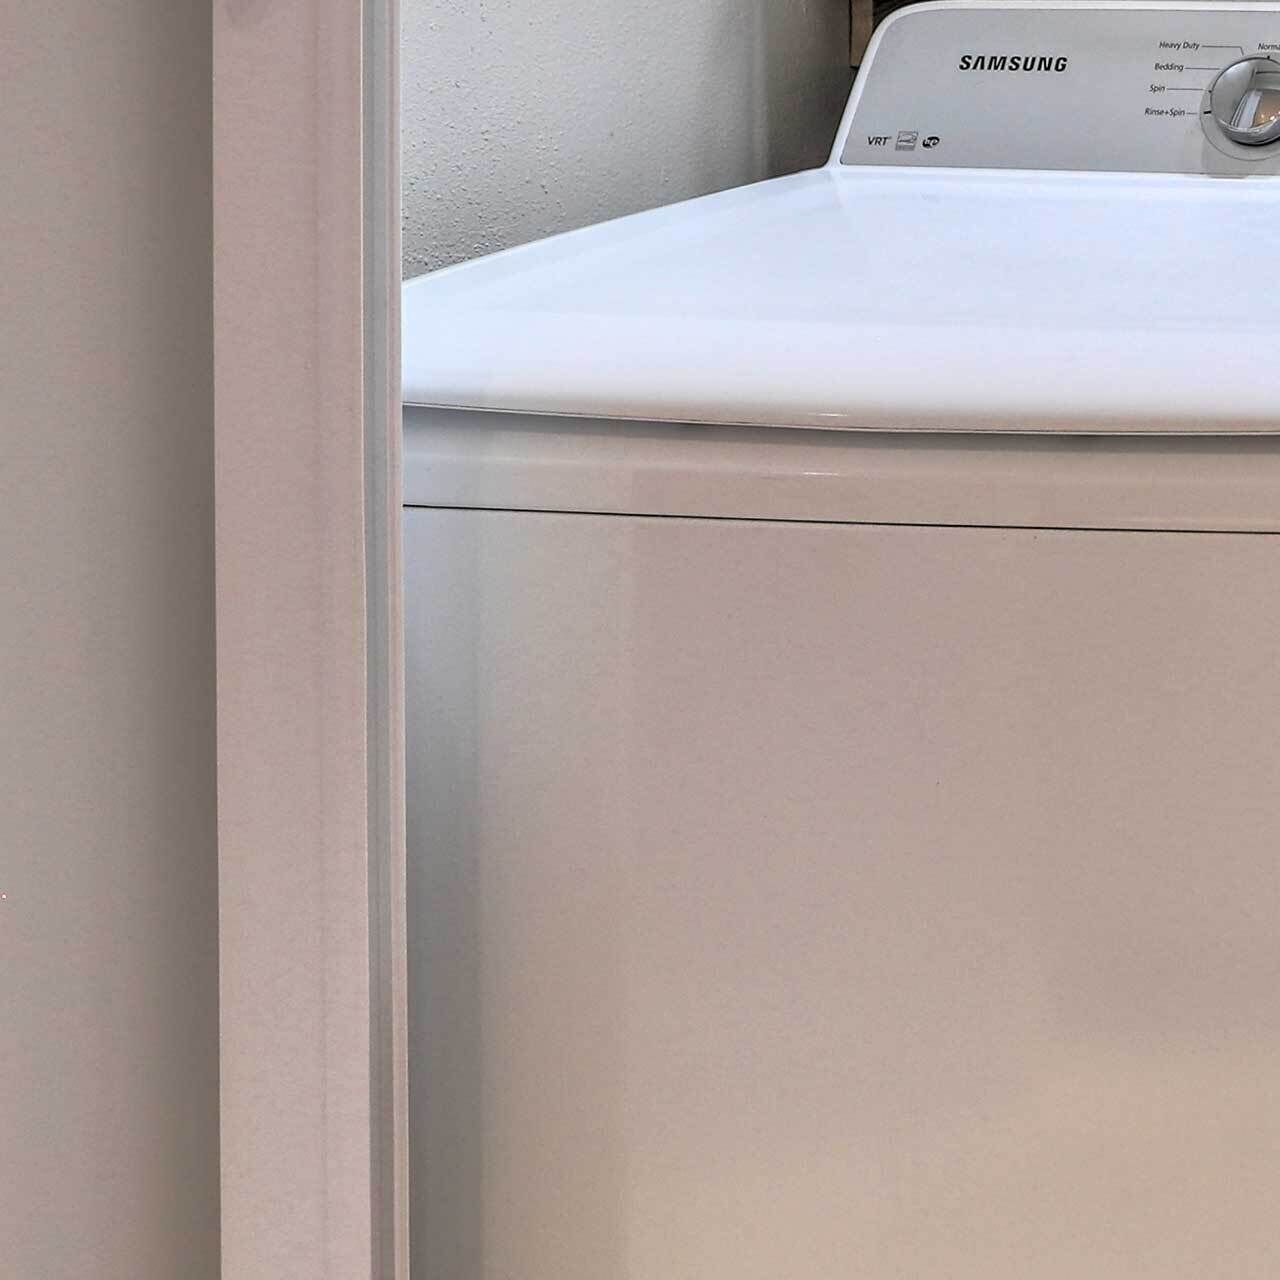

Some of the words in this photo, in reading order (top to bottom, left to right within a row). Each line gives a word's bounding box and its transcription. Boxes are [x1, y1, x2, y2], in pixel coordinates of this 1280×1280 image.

[1159, 41, 1181, 51] Heavy
[1182, 42, 1200, 51] Duty
[959, 54, 1068, 72] SAMSUNG
[1154, 63, 1184, 71] Bedding
[1150, 84, 1166, 93] Spin
